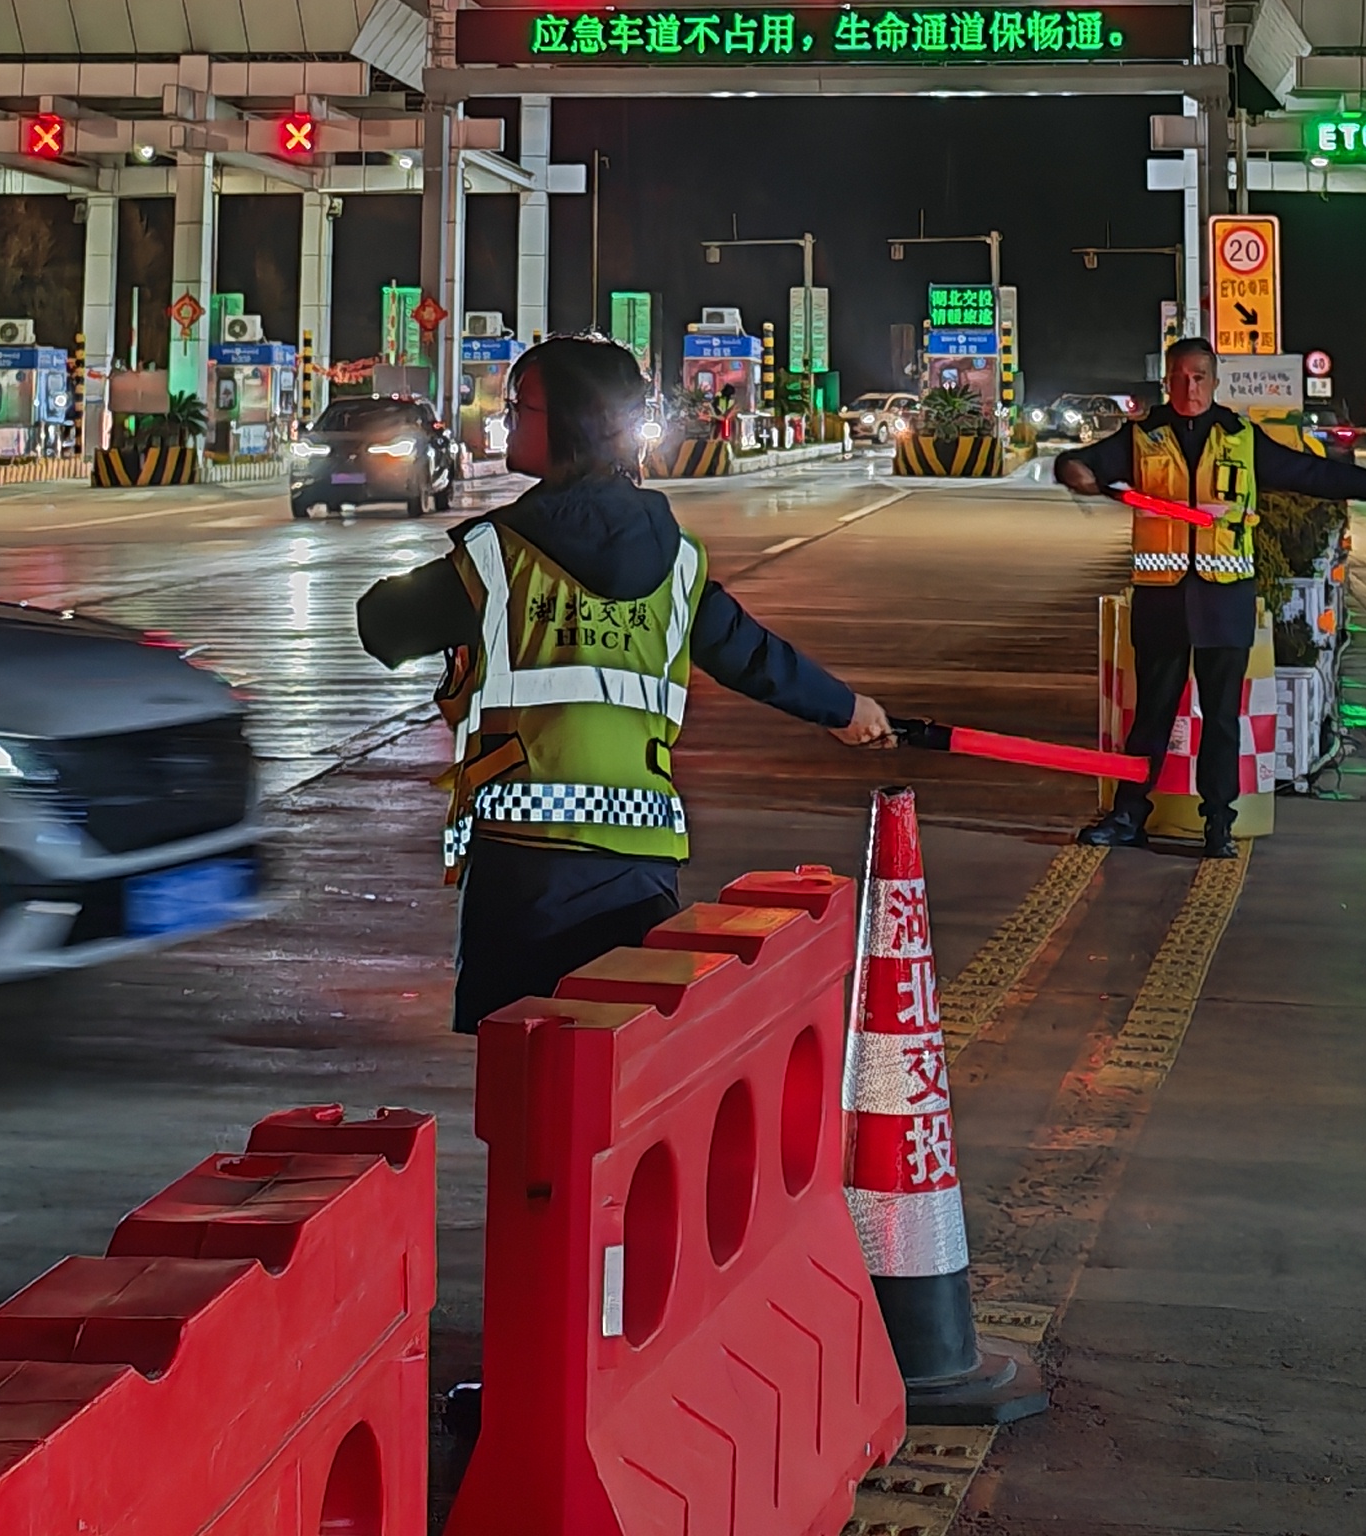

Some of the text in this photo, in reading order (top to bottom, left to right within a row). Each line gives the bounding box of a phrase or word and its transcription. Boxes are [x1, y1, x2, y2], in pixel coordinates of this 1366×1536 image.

[531, 12, 1125, 56] 应急车道不占用，生命通道保畅通。
[1229, 239, 1261, 262] 20
[931, 289, 994, 307] 湖北交投
[529, 593, 651, 632] 湖北交投
[554, 627, 633, 652] HBCI
[889, 884, 957, 1186] 湖北交投
